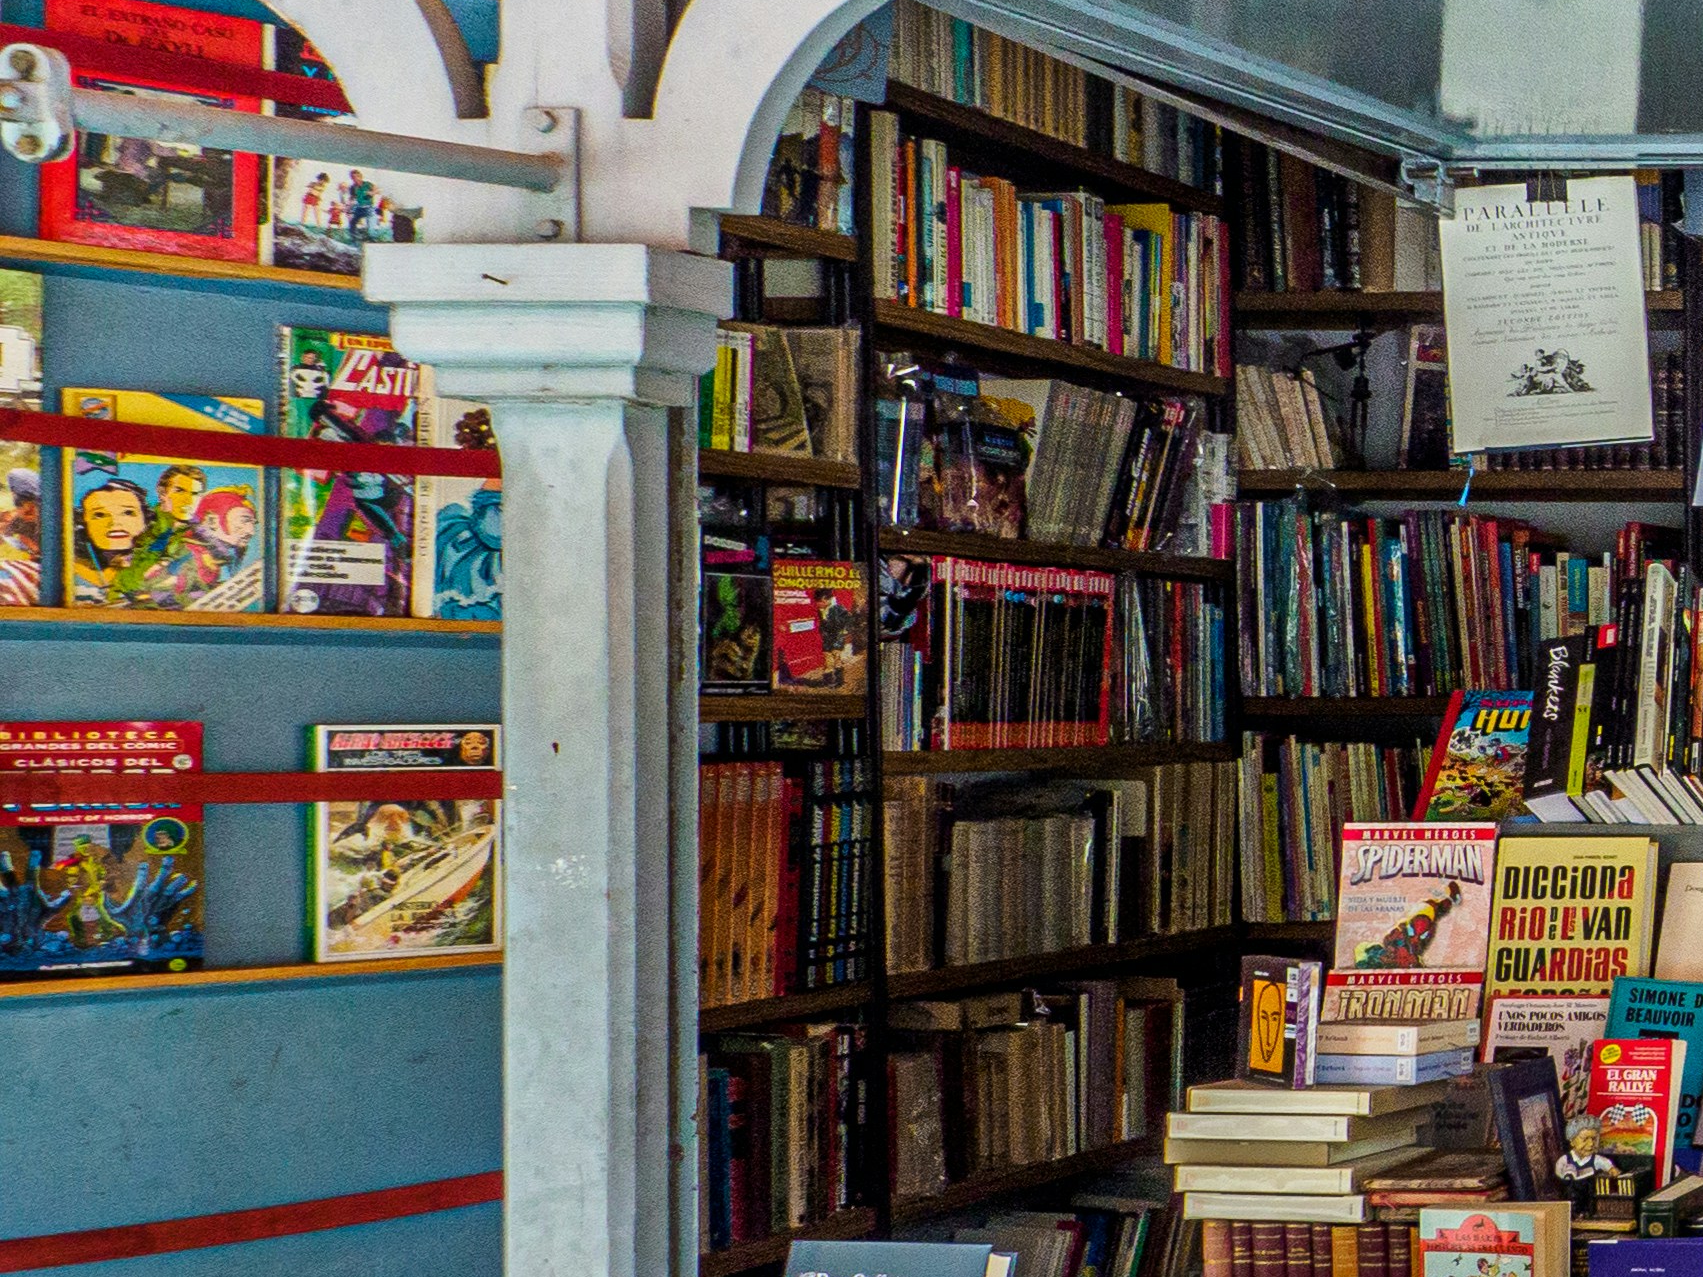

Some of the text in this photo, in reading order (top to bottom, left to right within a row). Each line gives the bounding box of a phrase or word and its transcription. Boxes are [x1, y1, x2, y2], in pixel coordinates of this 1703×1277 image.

[85, 742, 120, 751] DEL
[124, 757, 163, 767] DEL
[1351, 844, 1486, 886] SPIDERMAN
[1628, 988, 1689, 1007] SIMONE
[1625, 1007, 1696, 1026] BEAUVOIR
[1605, 1069, 1658, 1081] EL GRAN
[1608, 1081, 1653, 1093] RALLYE
